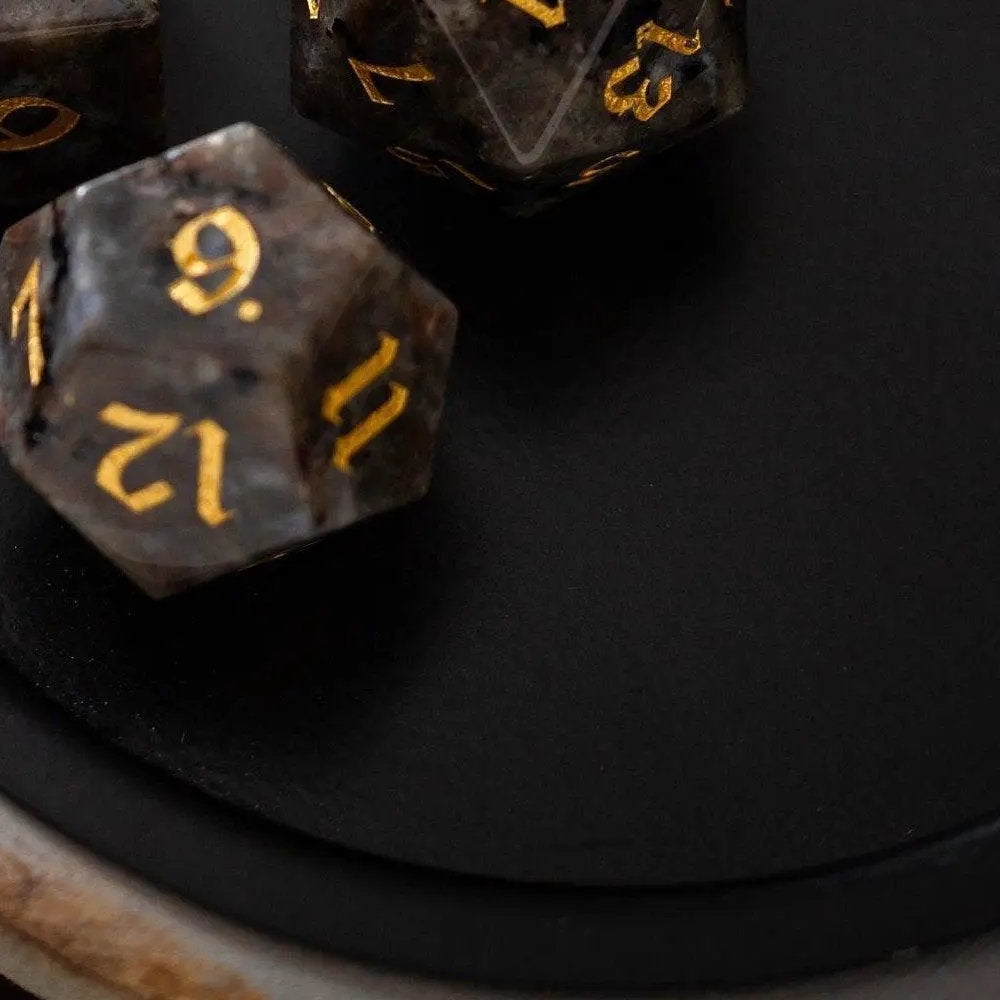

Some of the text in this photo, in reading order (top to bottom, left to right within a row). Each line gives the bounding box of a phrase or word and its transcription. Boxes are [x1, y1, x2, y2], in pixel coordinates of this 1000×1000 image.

[604, 19, 701, 121] 13
[95, 402, 234, 527] 12
[321, 332, 409, 474] 11
